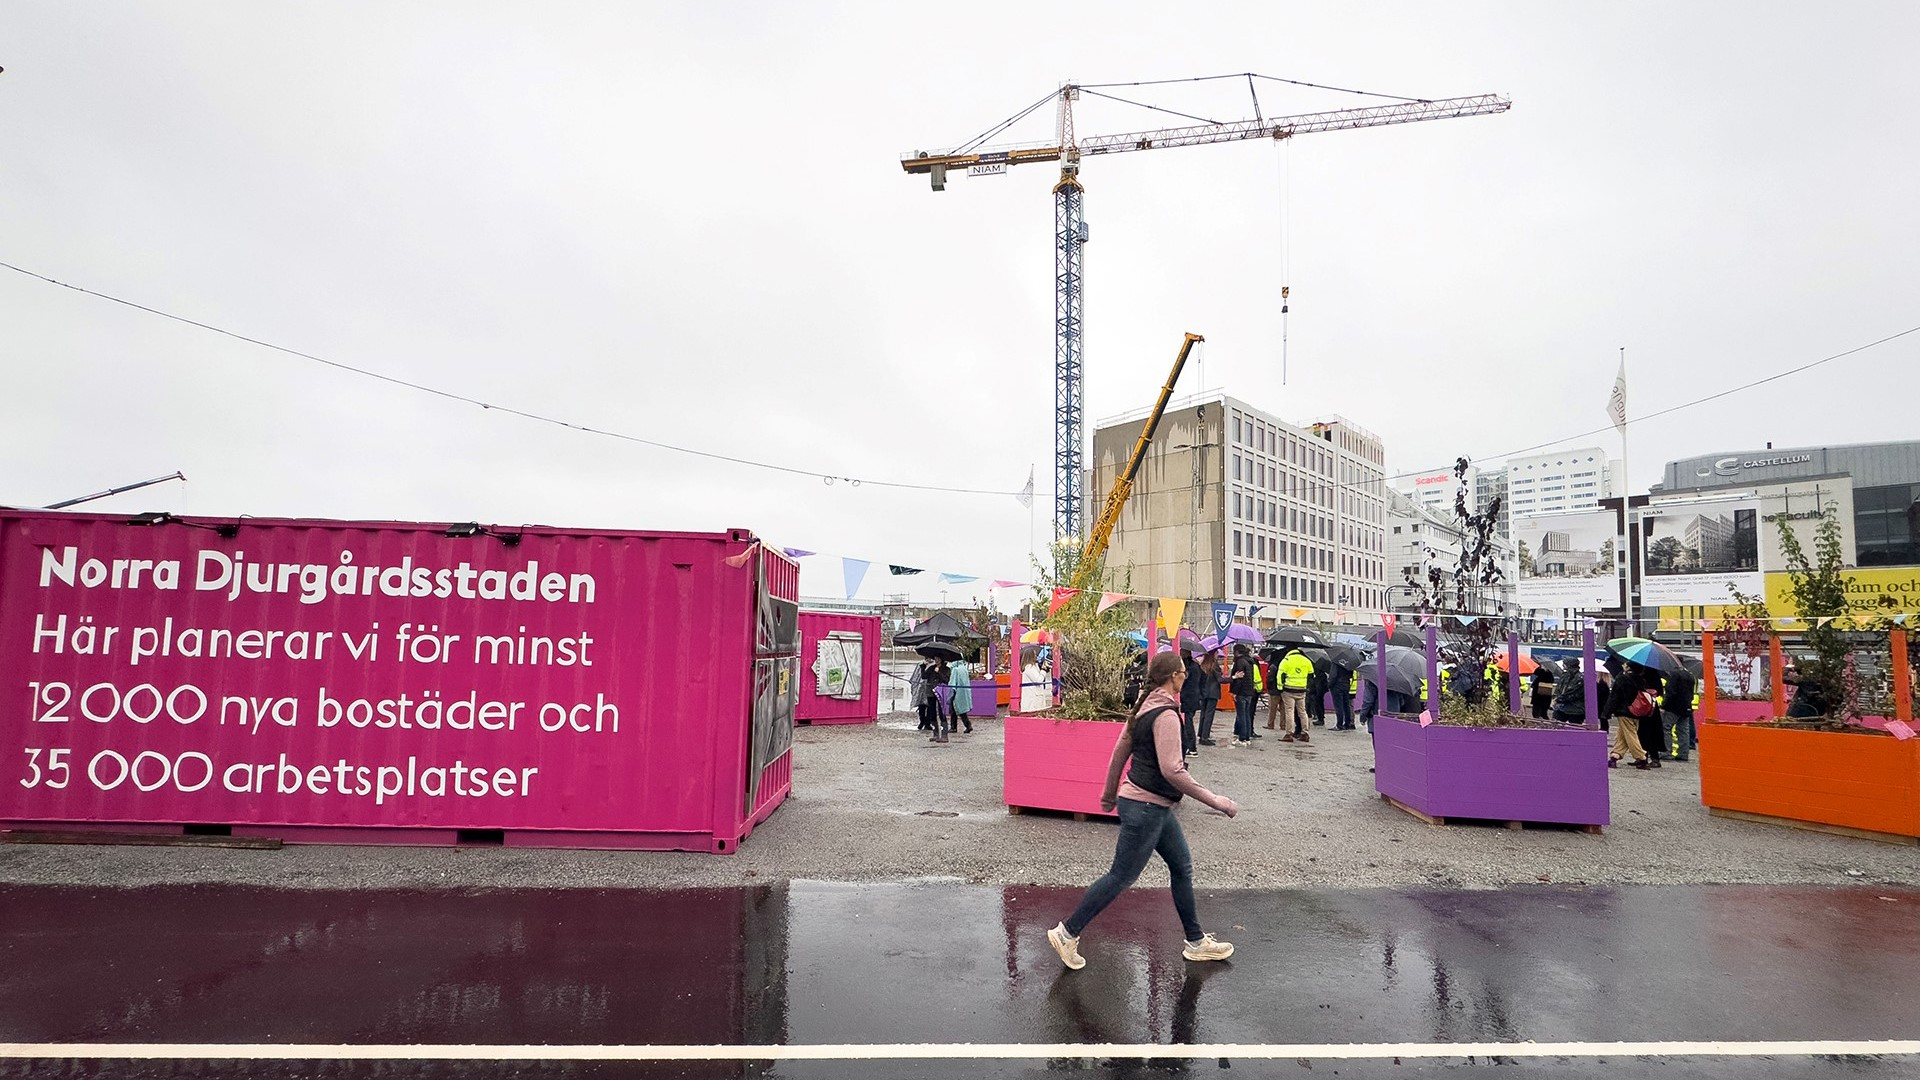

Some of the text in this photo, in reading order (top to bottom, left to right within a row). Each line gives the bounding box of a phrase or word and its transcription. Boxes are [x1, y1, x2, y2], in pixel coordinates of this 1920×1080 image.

[973, 165, 1001, 173] NIAM
[1743, 454, 1811, 468] CASTELLUM
[1415, 474, 1449, 486] Scandic
[39, 546, 596, 605] Norra Djurgårdsstaden
[1886, 578, 1920, 593] och
[32, 613, 594, 667] Här planerar vi för minst
[220, 696, 298, 736] nya
[317, 687, 526, 731] bostäder
[539, 692, 619, 733] och
[222, 753, 539, 805] arbetsplatser
